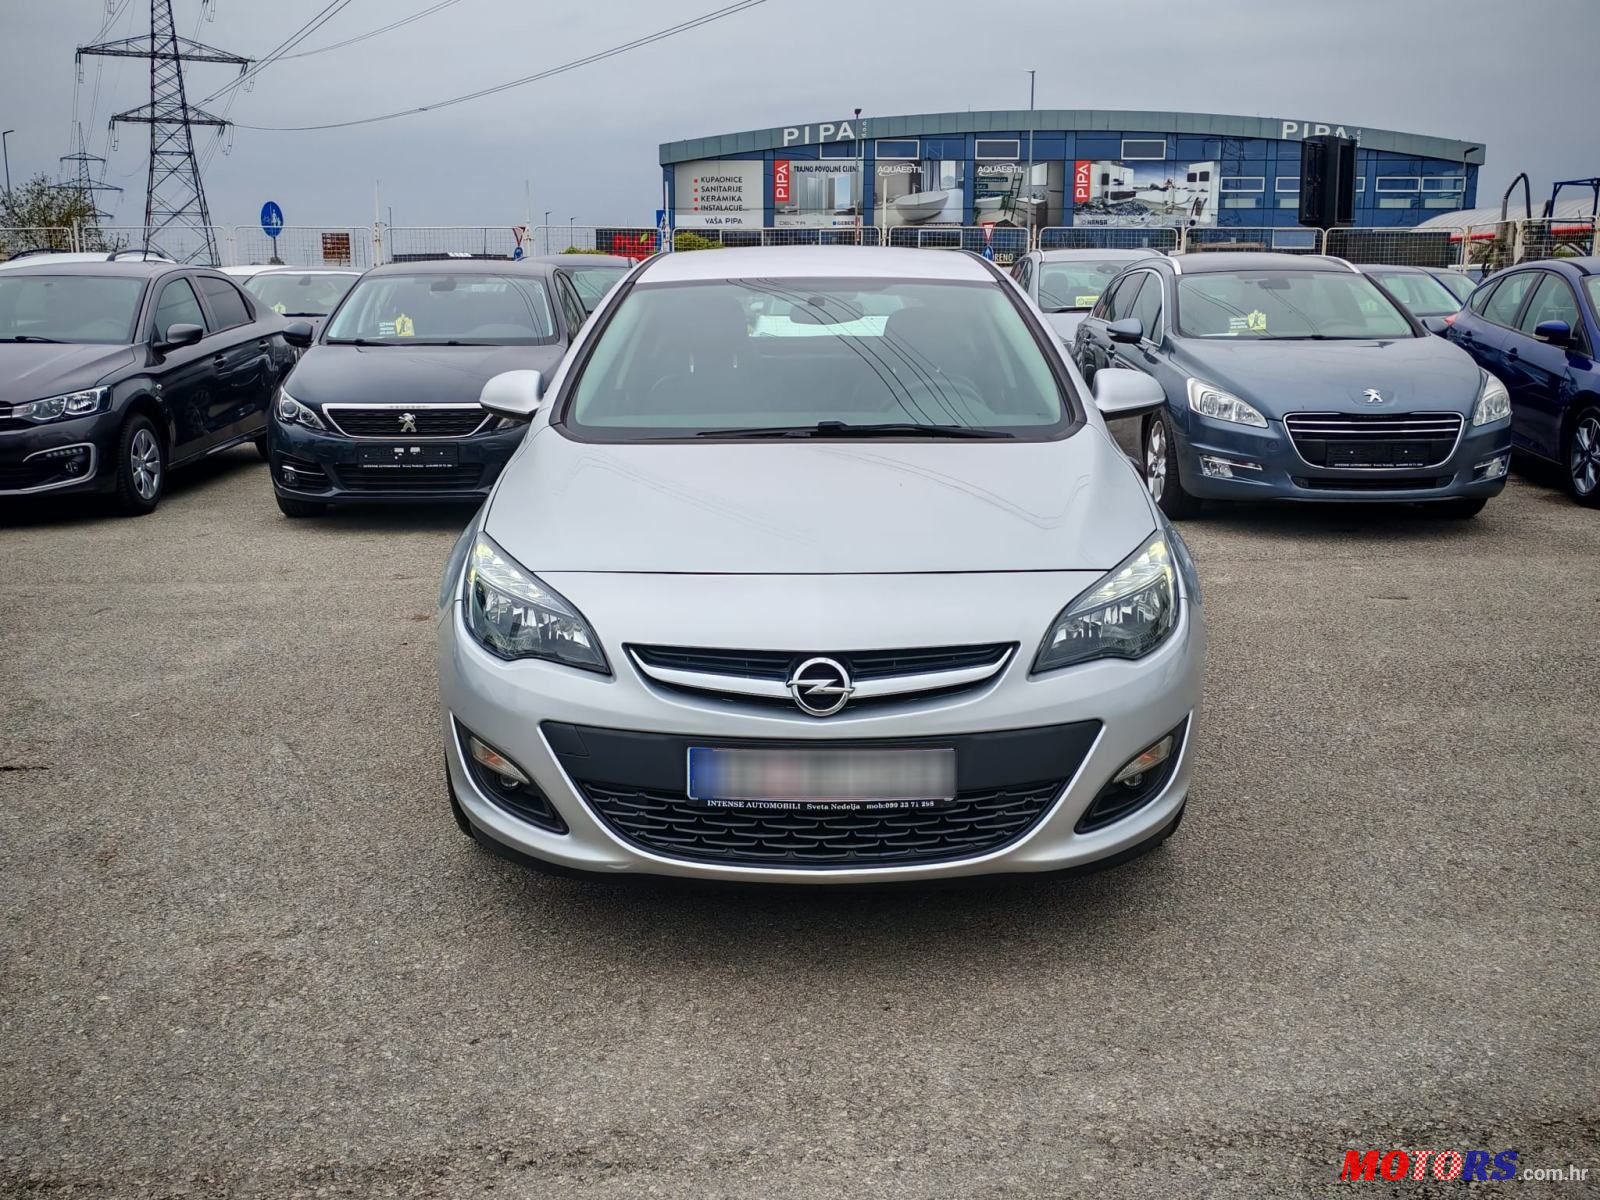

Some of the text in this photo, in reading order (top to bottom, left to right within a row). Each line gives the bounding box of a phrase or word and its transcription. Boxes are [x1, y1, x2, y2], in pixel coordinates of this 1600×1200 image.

[783, 121, 855, 147] PIPA
[1281, 121, 1348, 140] PIPA
[793, 165, 813, 173] TRAJNO
[814, 165, 841, 173] POVOLJNE
[877, 165, 925, 174] AQUAESTIL
[977, 165, 1024, 174] AQUAESTIL
[701, 176, 743, 184] KUPAONICE
[776, 163, 788, 198] PIPA
[1076, 164, 1089, 198] PIPA
[701, 185, 743, 193] SANITARIJE
[704, 216, 743, 225] VAŠA PIPA
[707, 800, 745, 808] INTENSE
[746, 801, 801, 810] AUTOMOBILI
[831, 803, 861, 811] Nedelja
